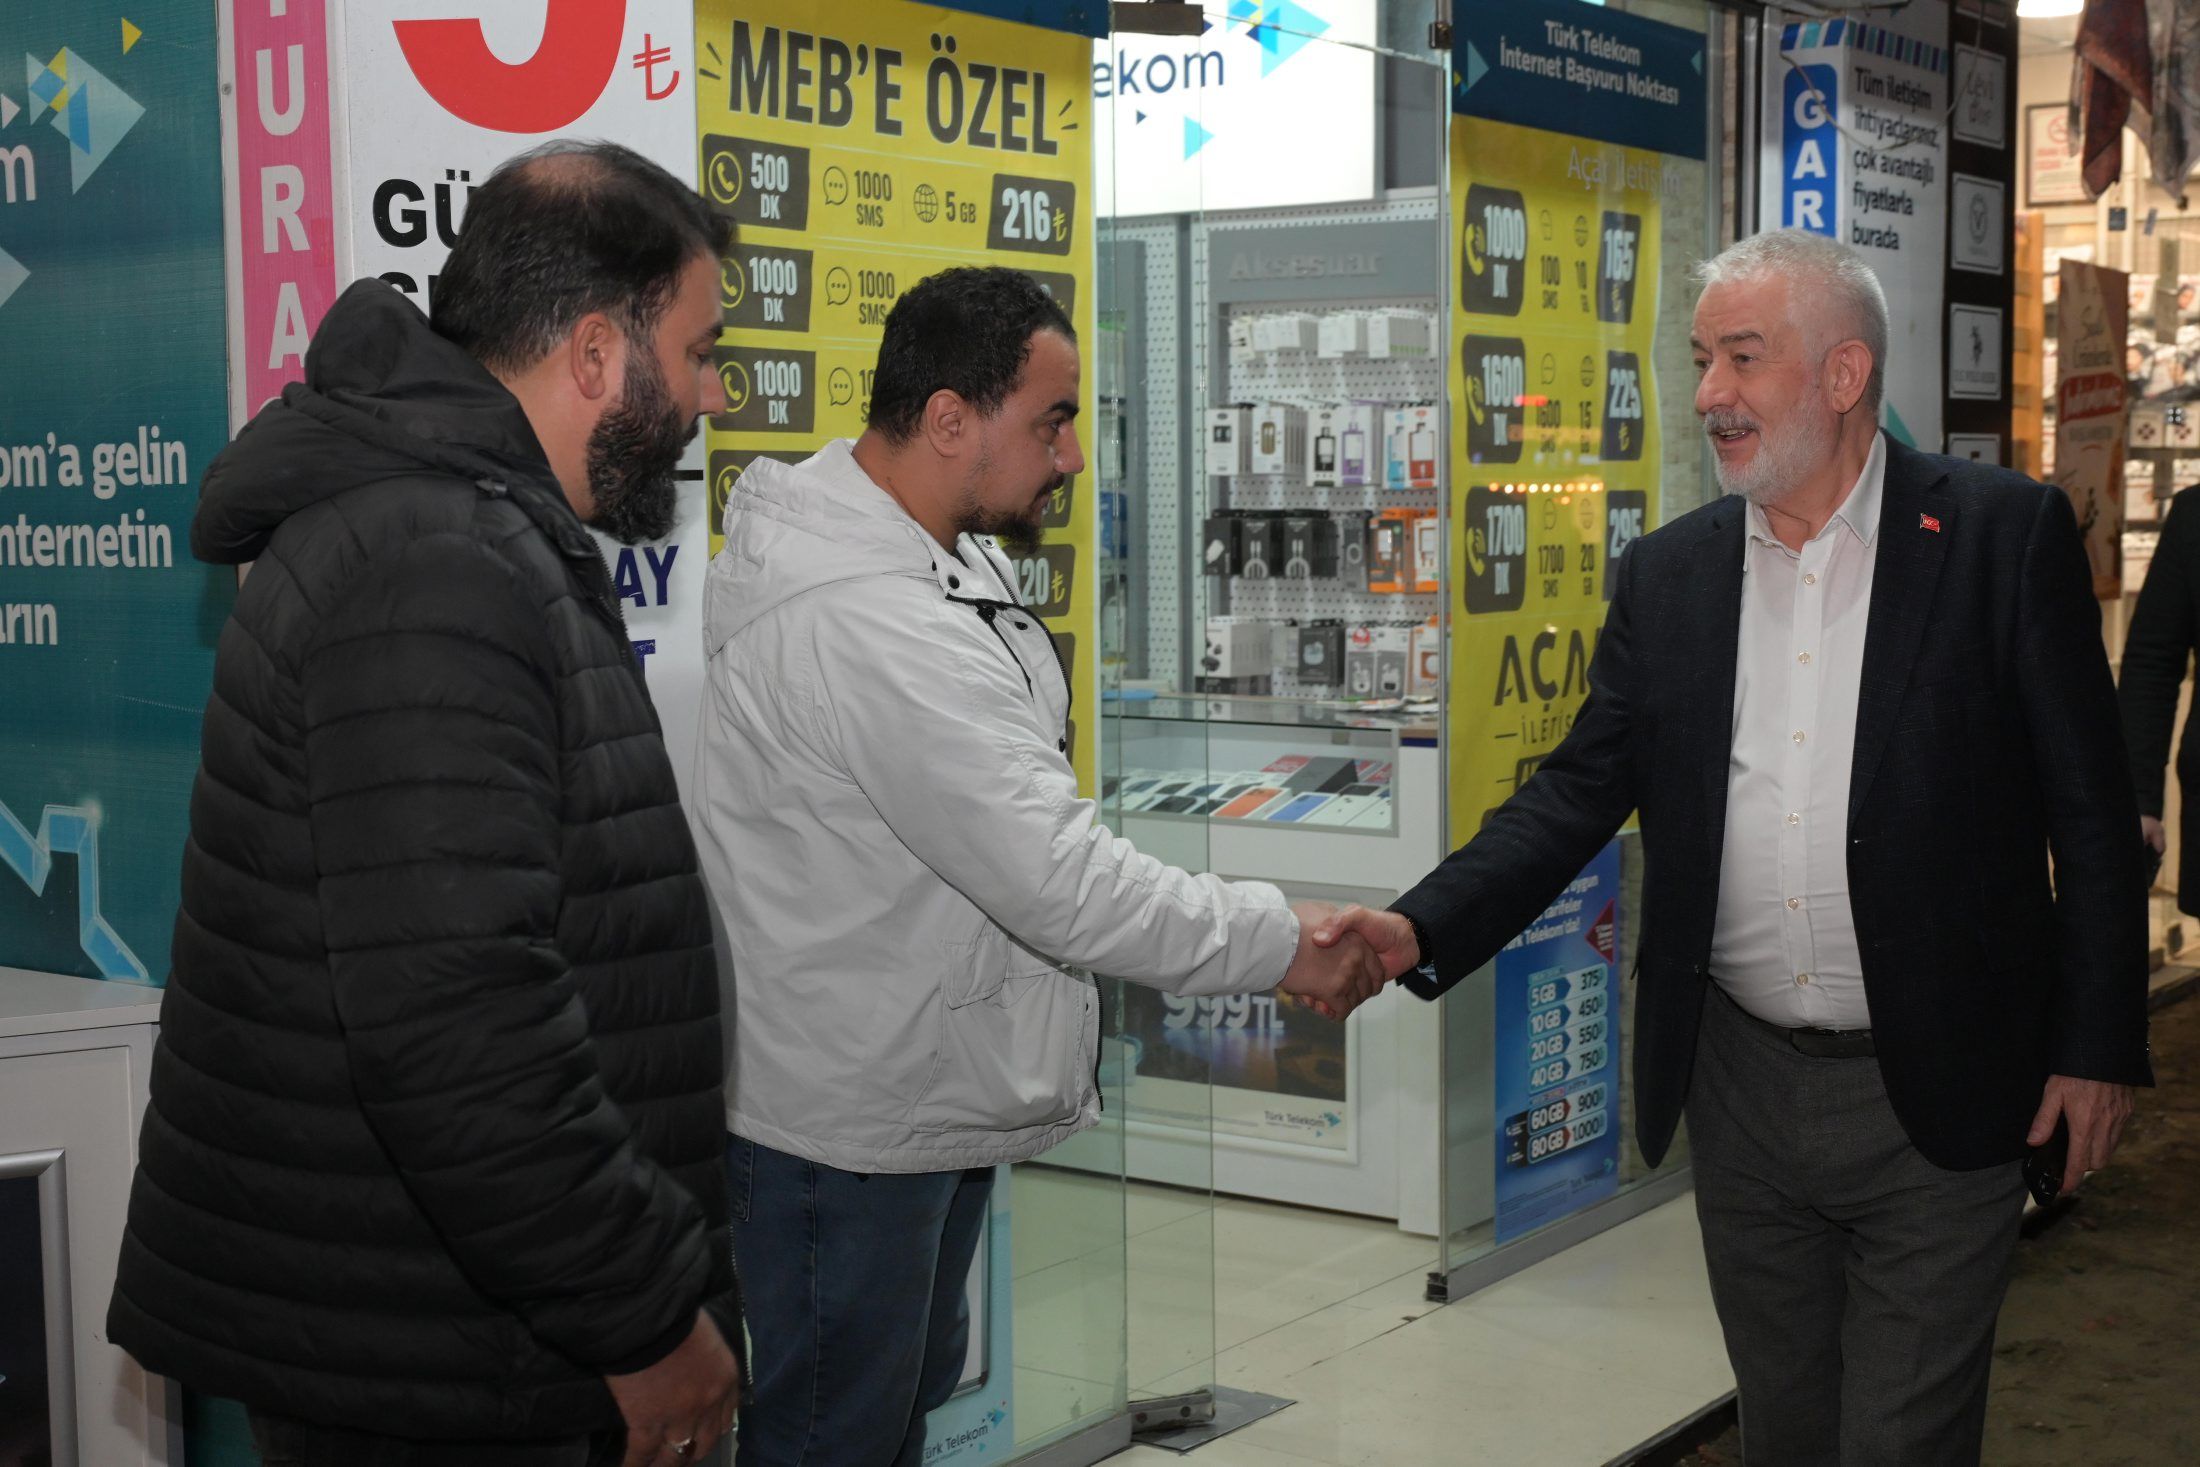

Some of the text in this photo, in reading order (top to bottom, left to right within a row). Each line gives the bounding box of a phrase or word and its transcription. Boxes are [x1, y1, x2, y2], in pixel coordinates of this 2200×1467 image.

[1544, 20, 1642, 67] Türk Telekom
[729, 19, 903, 137] MEB'E
[926, 33, 1058, 156] ÖZEL
[1499, 35, 1680, 106] İnternet Başvuru Noktası
[1855, 67, 1884, 98] Tüm
[1887, 73, 1932, 113] iletişim
[750, 153, 789, 193] 500
[1854, 148, 1934, 188] çok avantajlı
[854, 170, 892, 202] 1000
[1853, 181, 1914, 217] fiyatlarla
[759, 195, 781, 221] DK
[856, 203, 885, 228] SMS
[945, 191, 976, 224] 5 GB
[1483, 204, 1526, 261] 1000
[1852, 218, 1900, 251] burada
[749, 256, 798, 297] 1000
[1228, 251, 1383, 282] Aksesuar
[858, 269, 895, 300] 1000
[763, 297, 785, 323] DK
[753, 359, 801, 398] 1000
[1481, 354, 1525, 407] 1600
[1609, 367, 1642, 420] 225
[768, 400, 789, 425] DK
[92, 425, 188, 500] gelin
[1486, 504, 1526, 557] 1700
[1538, 544, 1565, 574] 1700
[1580, 543, 1595, 573] 20
[0, 603, 58, 646] rın
[1493, 627, 1602, 712] AÇA
[1530, 982, 1557, 1007] 5 GB
[1530, 1008, 1562, 1035] 10 GB
[1530, 1034, 1564, 1062] 20 GB
[1530, 1068, 1546, 1088] 40
[1547, 1061, 1564, 1083] GB
[1531, 1108, 1547, 1130] 60
[1547, 1101, 1565, 1123] GB
[1531, 1136, 1547, 1159] 80
[1547, 1129, 1565, 1152] GB
[922, 1443, 943, 1459] ürk
[945, 1424, 989, 1451] Telekom
